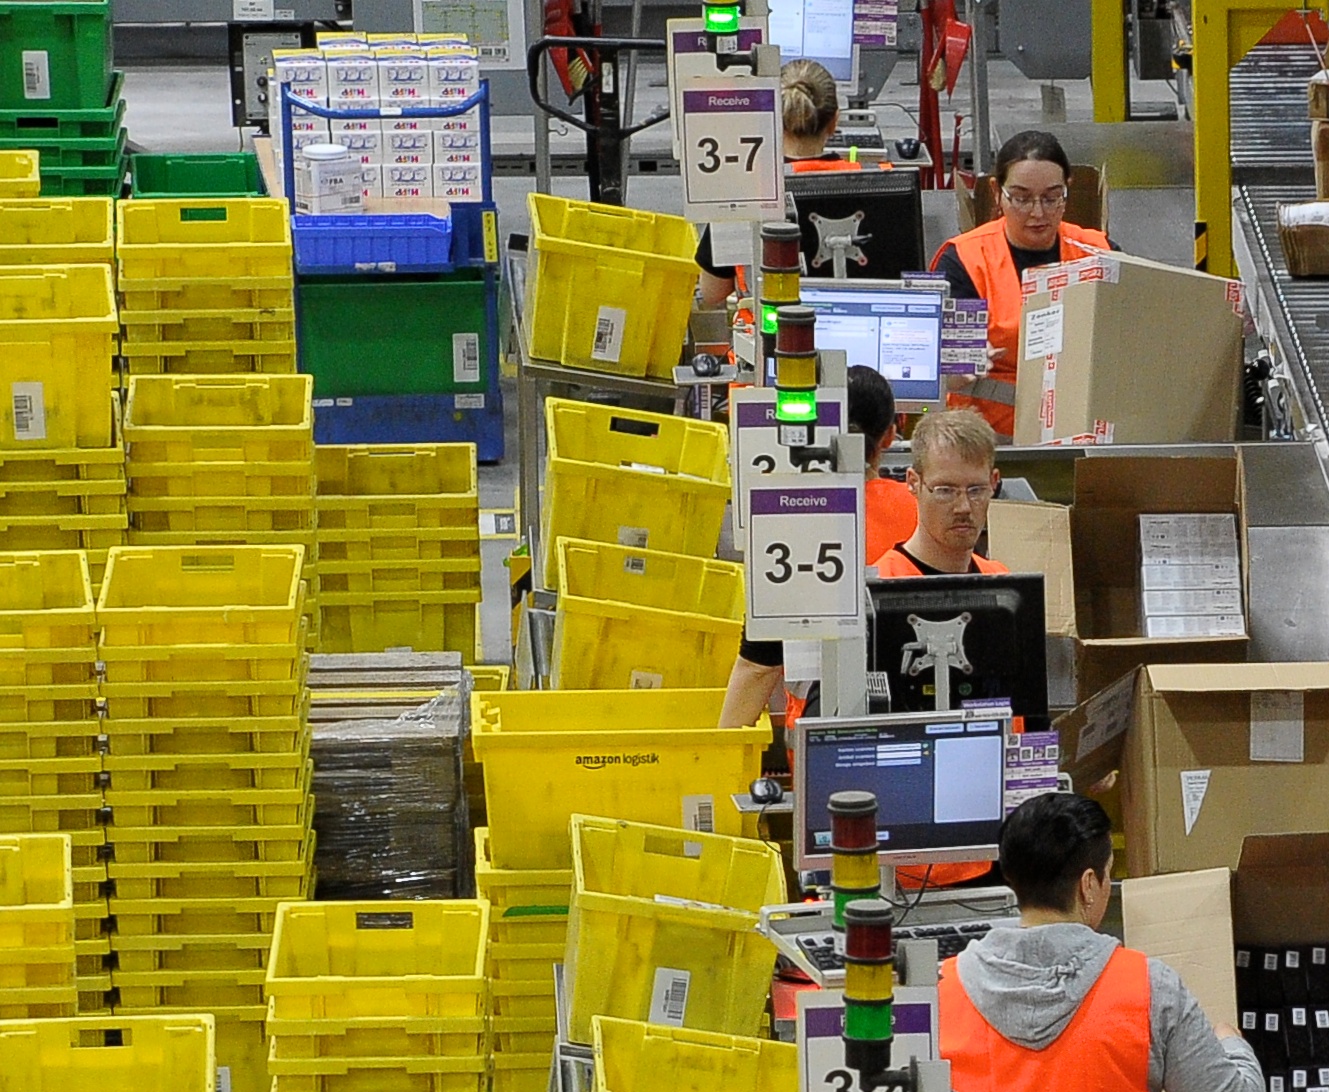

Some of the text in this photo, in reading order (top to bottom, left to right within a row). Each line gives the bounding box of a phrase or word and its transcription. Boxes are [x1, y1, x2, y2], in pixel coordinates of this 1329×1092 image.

[708, 96, 750, 106] Receive
[697, 137, 764, 173] 3-7
[779, 496, 827, 507] Receive
[765, 543, 844, 583] 3-5
[575, 753, 659, 768] amazon logistik
